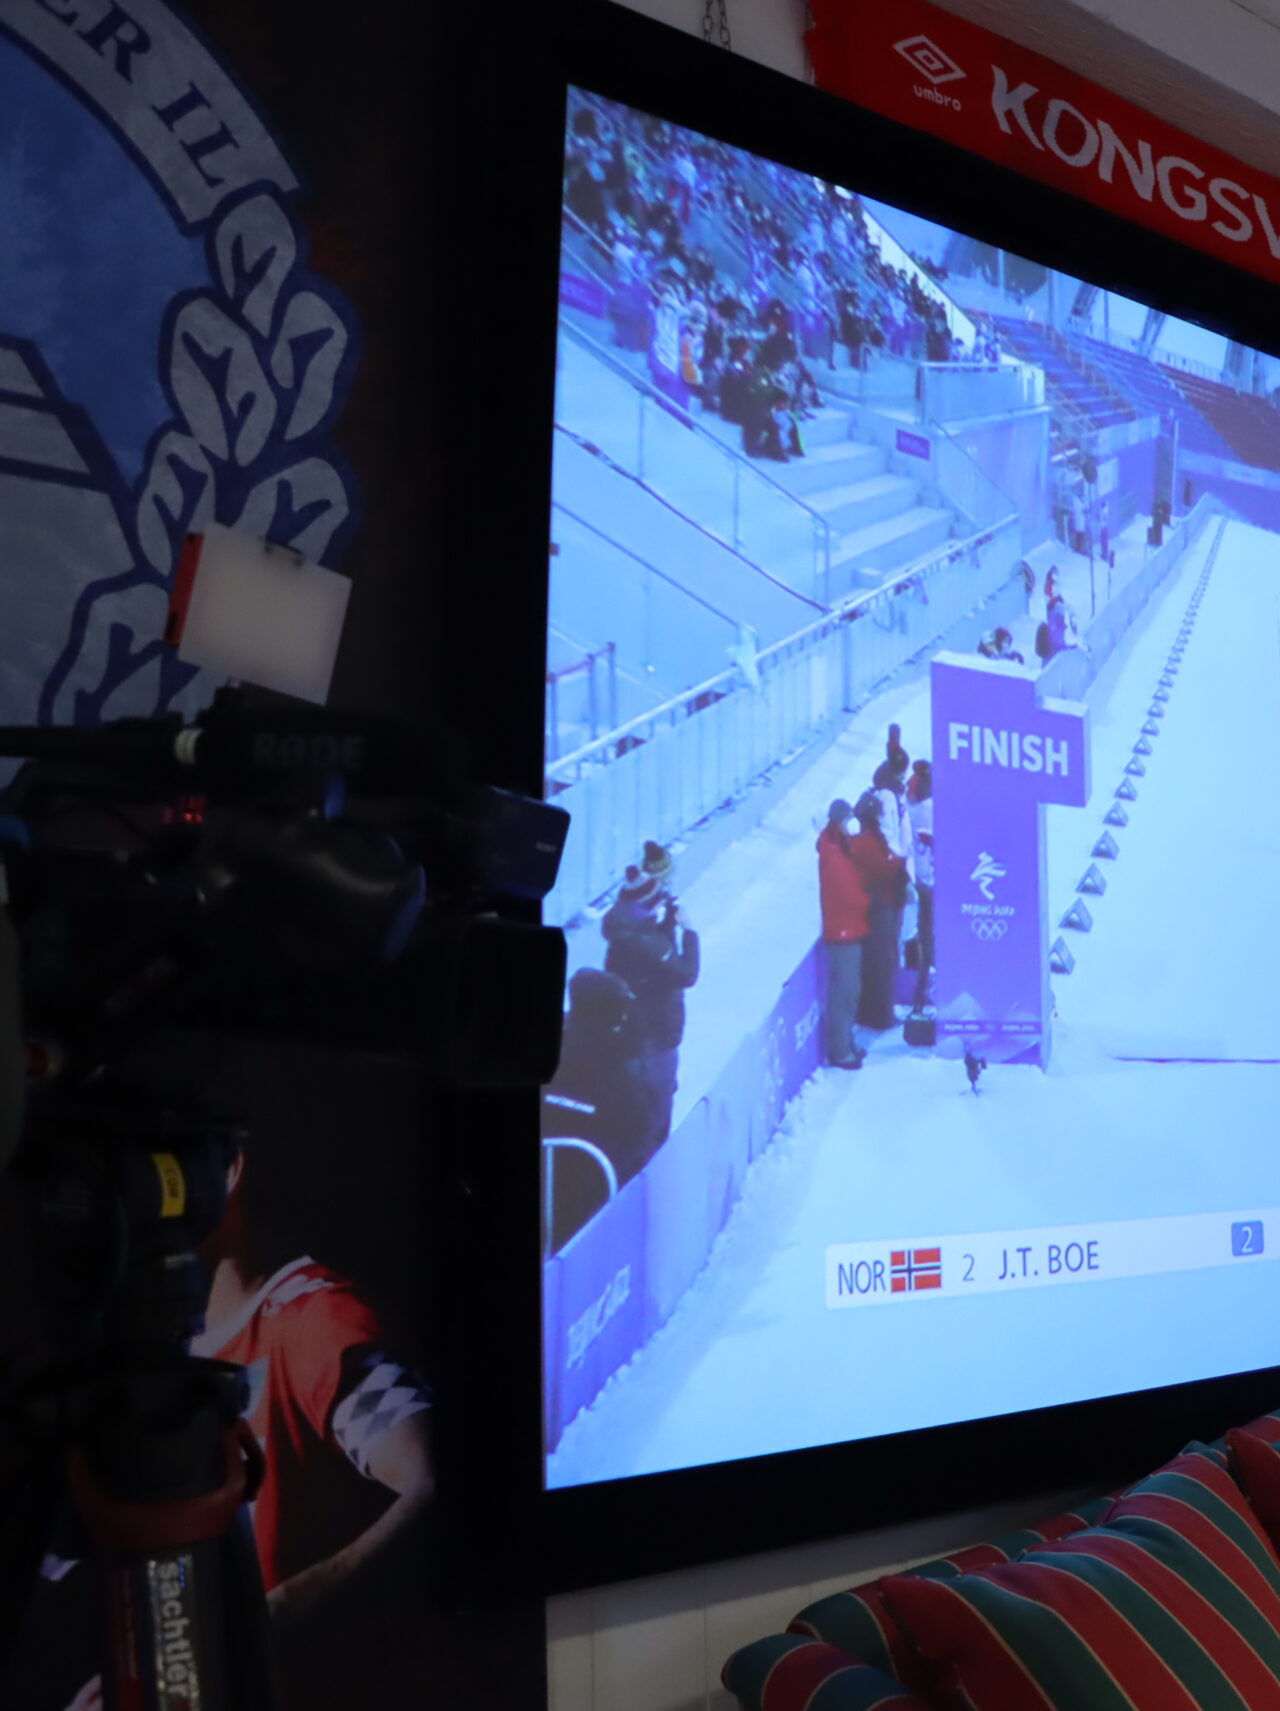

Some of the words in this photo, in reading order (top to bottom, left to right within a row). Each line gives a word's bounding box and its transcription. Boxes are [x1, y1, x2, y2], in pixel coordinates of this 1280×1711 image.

[913, 84, 962, 112] umbro
[151, 82, 240, 188] IL
[947, 722, 1070, 777] FINISH
[838, 1260, 887, 1297] NOR
[962, 1253, 975, 1282] 2
[998, 1247, 1040, 1281] J.T.
[1048, 1240, 1100, 1273] BOE
[1240, 1225, 1254, 1252] 2
[157, 1561, 193, 1697] sachtler
